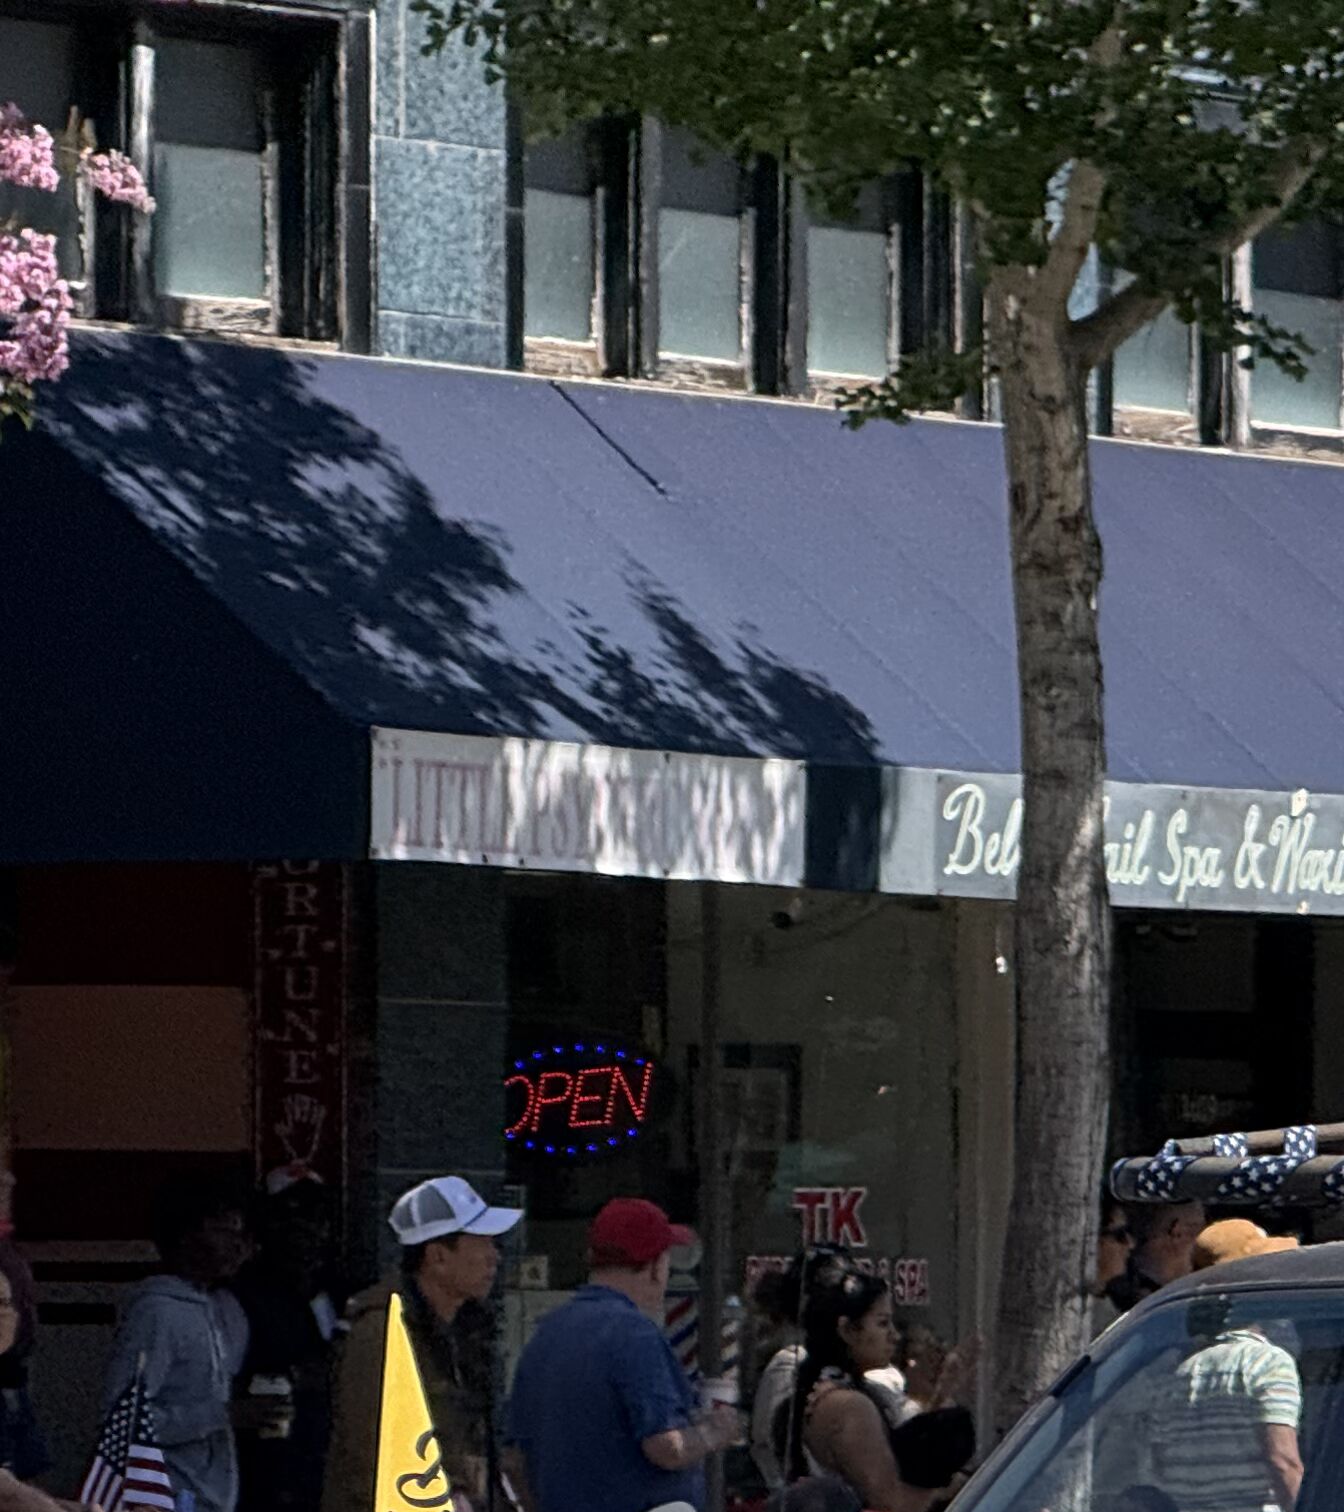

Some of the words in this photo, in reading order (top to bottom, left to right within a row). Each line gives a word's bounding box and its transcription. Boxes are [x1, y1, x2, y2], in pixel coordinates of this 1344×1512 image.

[1103, 796, 1155, 886] ail
[1158, 808, 1225, 902] Spa
[1234, 804, 1268, 889] &
[503, 1062, 653, 1133] OPEN
[792, 1187, 868, 1248] TK
